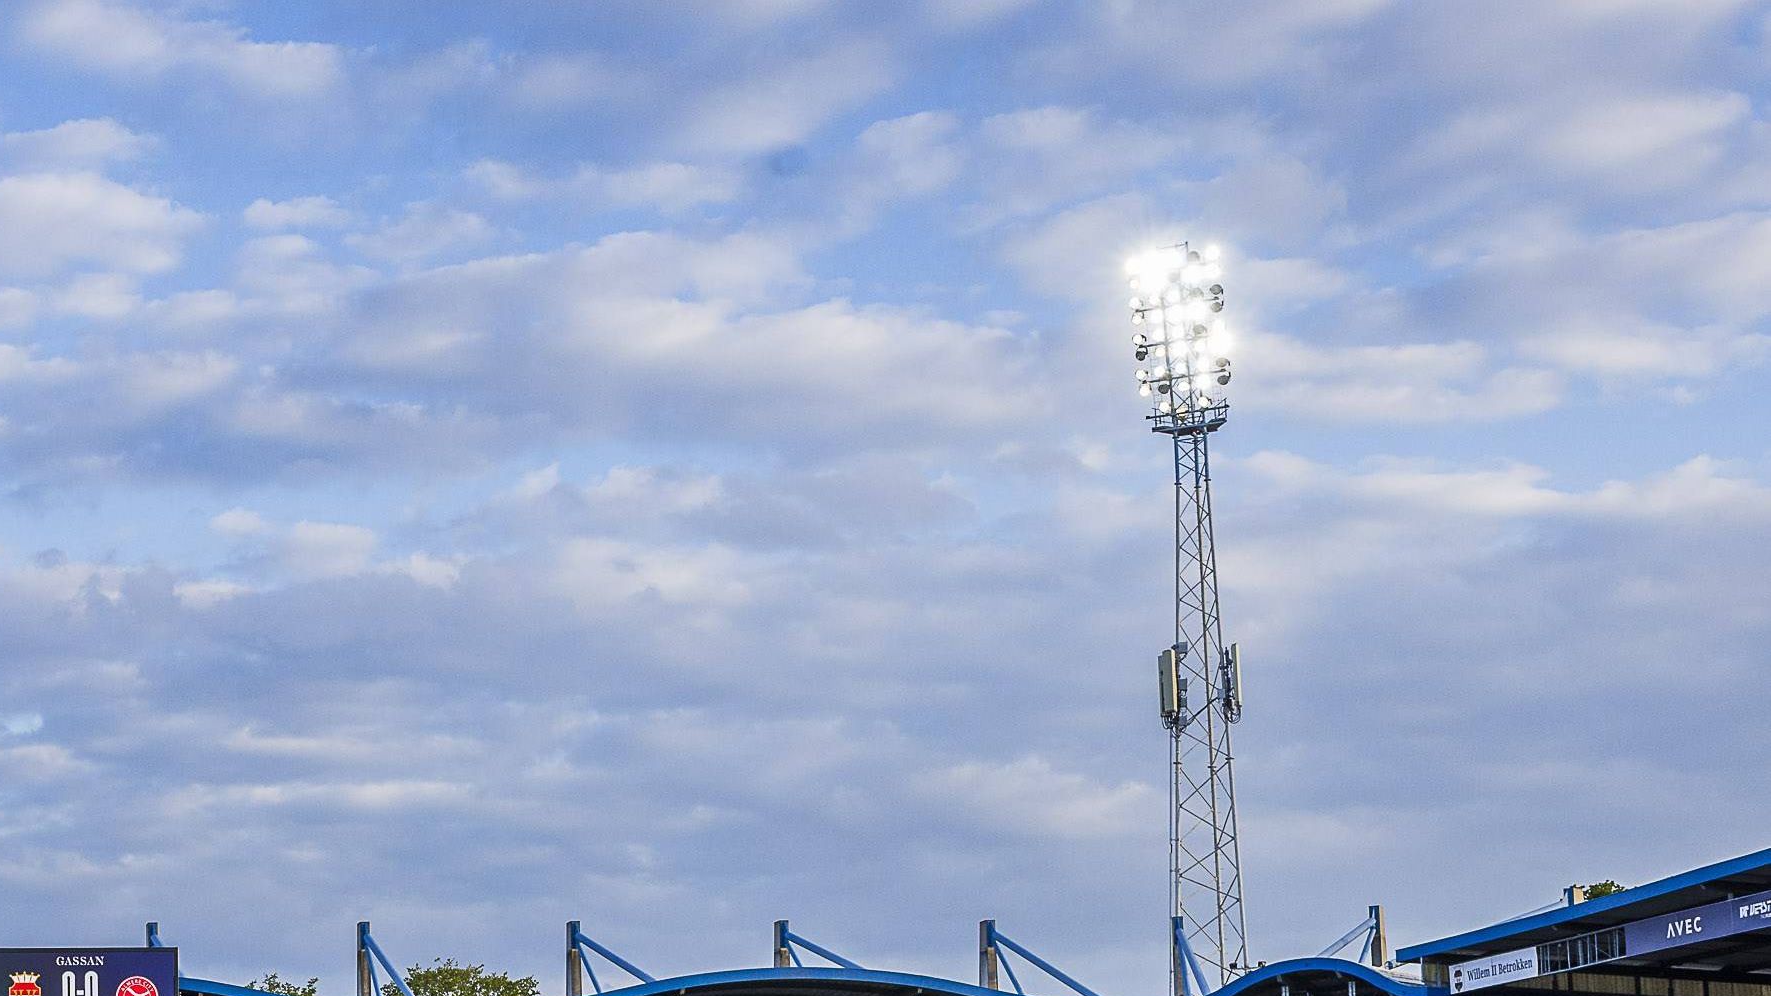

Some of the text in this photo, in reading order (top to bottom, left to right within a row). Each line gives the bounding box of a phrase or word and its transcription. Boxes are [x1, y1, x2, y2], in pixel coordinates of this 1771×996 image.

[1666, 916, 1702, 939] AVEC
[55, 956, 105, 966] GASSAN
[1467, 964, 1490, 981] Willem
[1498, 957, 1533, 977] Betrokken
